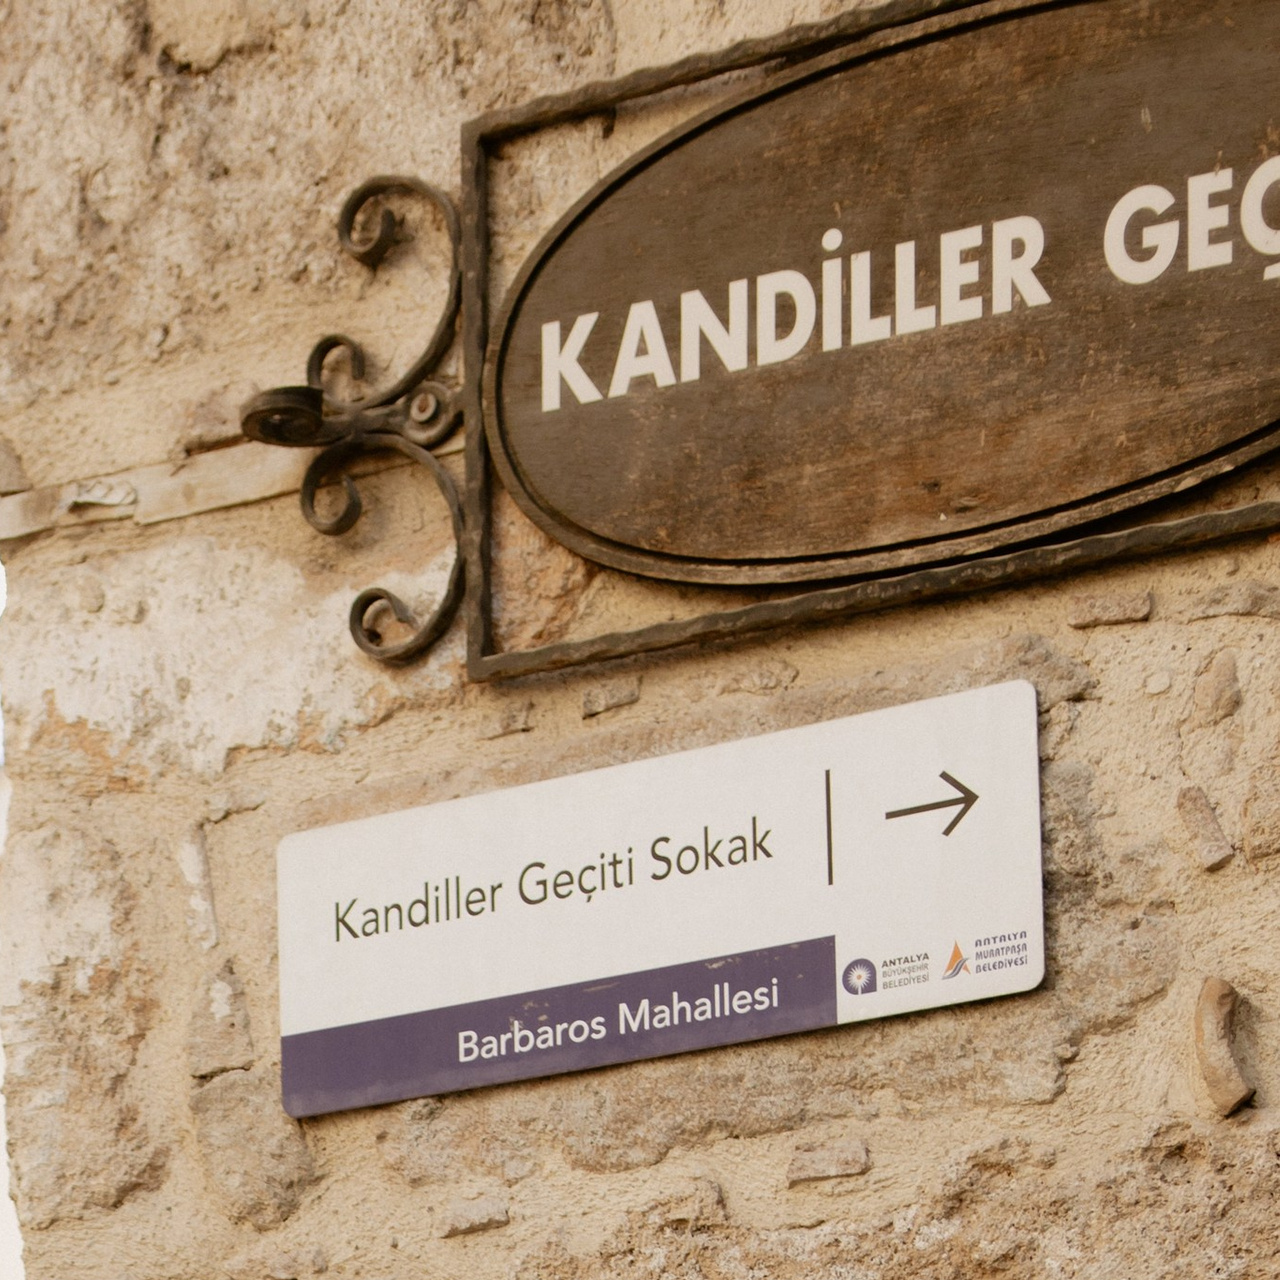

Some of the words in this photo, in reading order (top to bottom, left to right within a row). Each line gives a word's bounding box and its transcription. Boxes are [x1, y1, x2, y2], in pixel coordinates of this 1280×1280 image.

[541, 216, 1052, 412] KANDİLLER
[334, 874, 503, 943] Kandiller
[518, 846, 634, 905] Geçiti
[650, 815, 774, 882] Sokak
[975, 931, 1028, 947] ANTALYA
[881, 952, 930, 968] ANTALYA
[975, 942, 1028, 961] MURATPAŞA
[975, 954, 1029, 974] BELEDİYESİ
[882, 972, 930, 989] BELEDİYESİ
[457, 1017, 608, 1064] Barbaros
[618, 976, 780, 1036] Mahallesi
